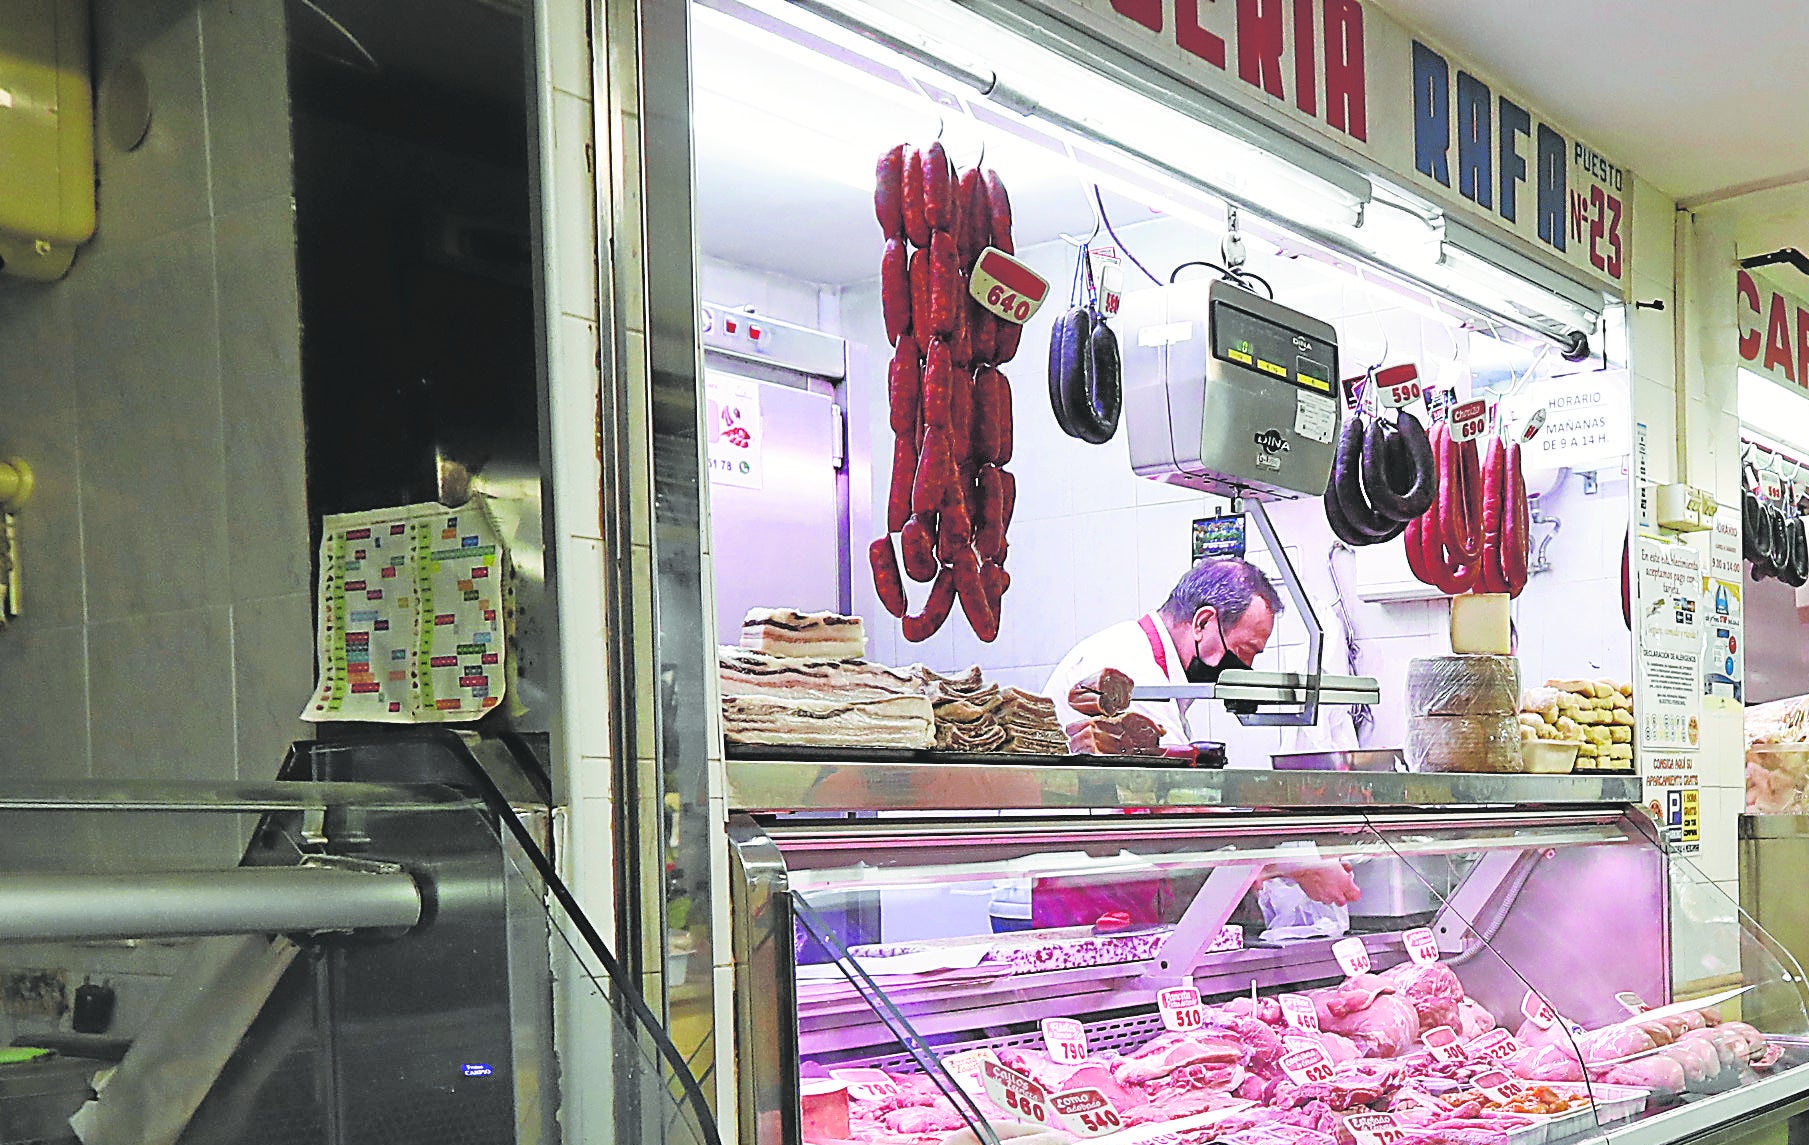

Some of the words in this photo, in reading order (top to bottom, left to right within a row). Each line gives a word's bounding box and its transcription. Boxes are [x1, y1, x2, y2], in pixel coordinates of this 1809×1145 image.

[1411, 38, 1567, 253] RAFA
[1574, 141, 1622, 192] PUESTO
[987, 284, 1031, 321] 640
[1292, 336, 1313, 352] DINA
[1391, 382, 1420, 404] 590
[1548, 391, 1601, 410] HORARIO
[1462, 418, 1485, 438] 690
[1546, 416, 1607, 435] MAÑANAS
[1256, 433, 1291, 452] DINA
[1543, 439, 1557, 451] DE
[1560, 438, 1567, 450] 9
[1582, 434, 1595, 448] 14
[1669, 792, 1680, 824] P
[1420, 945, 1437, 961] 440
[1349, 955, 1369, 972] 540
[1176, 1009, 1200, 1027] 510
[1297, 1013, 1316, 1029] 460
[1060, 1042, 1086, 1060] 790
[1443, 1043, 1465, 1060] 300
[1305, 1063, 1334, 1082] 620
[1497, 1082, 1522, 1099] 620
[1005, 1088, 1045, 1122] 560
[1079, 1109, 1120, 1132] 540
